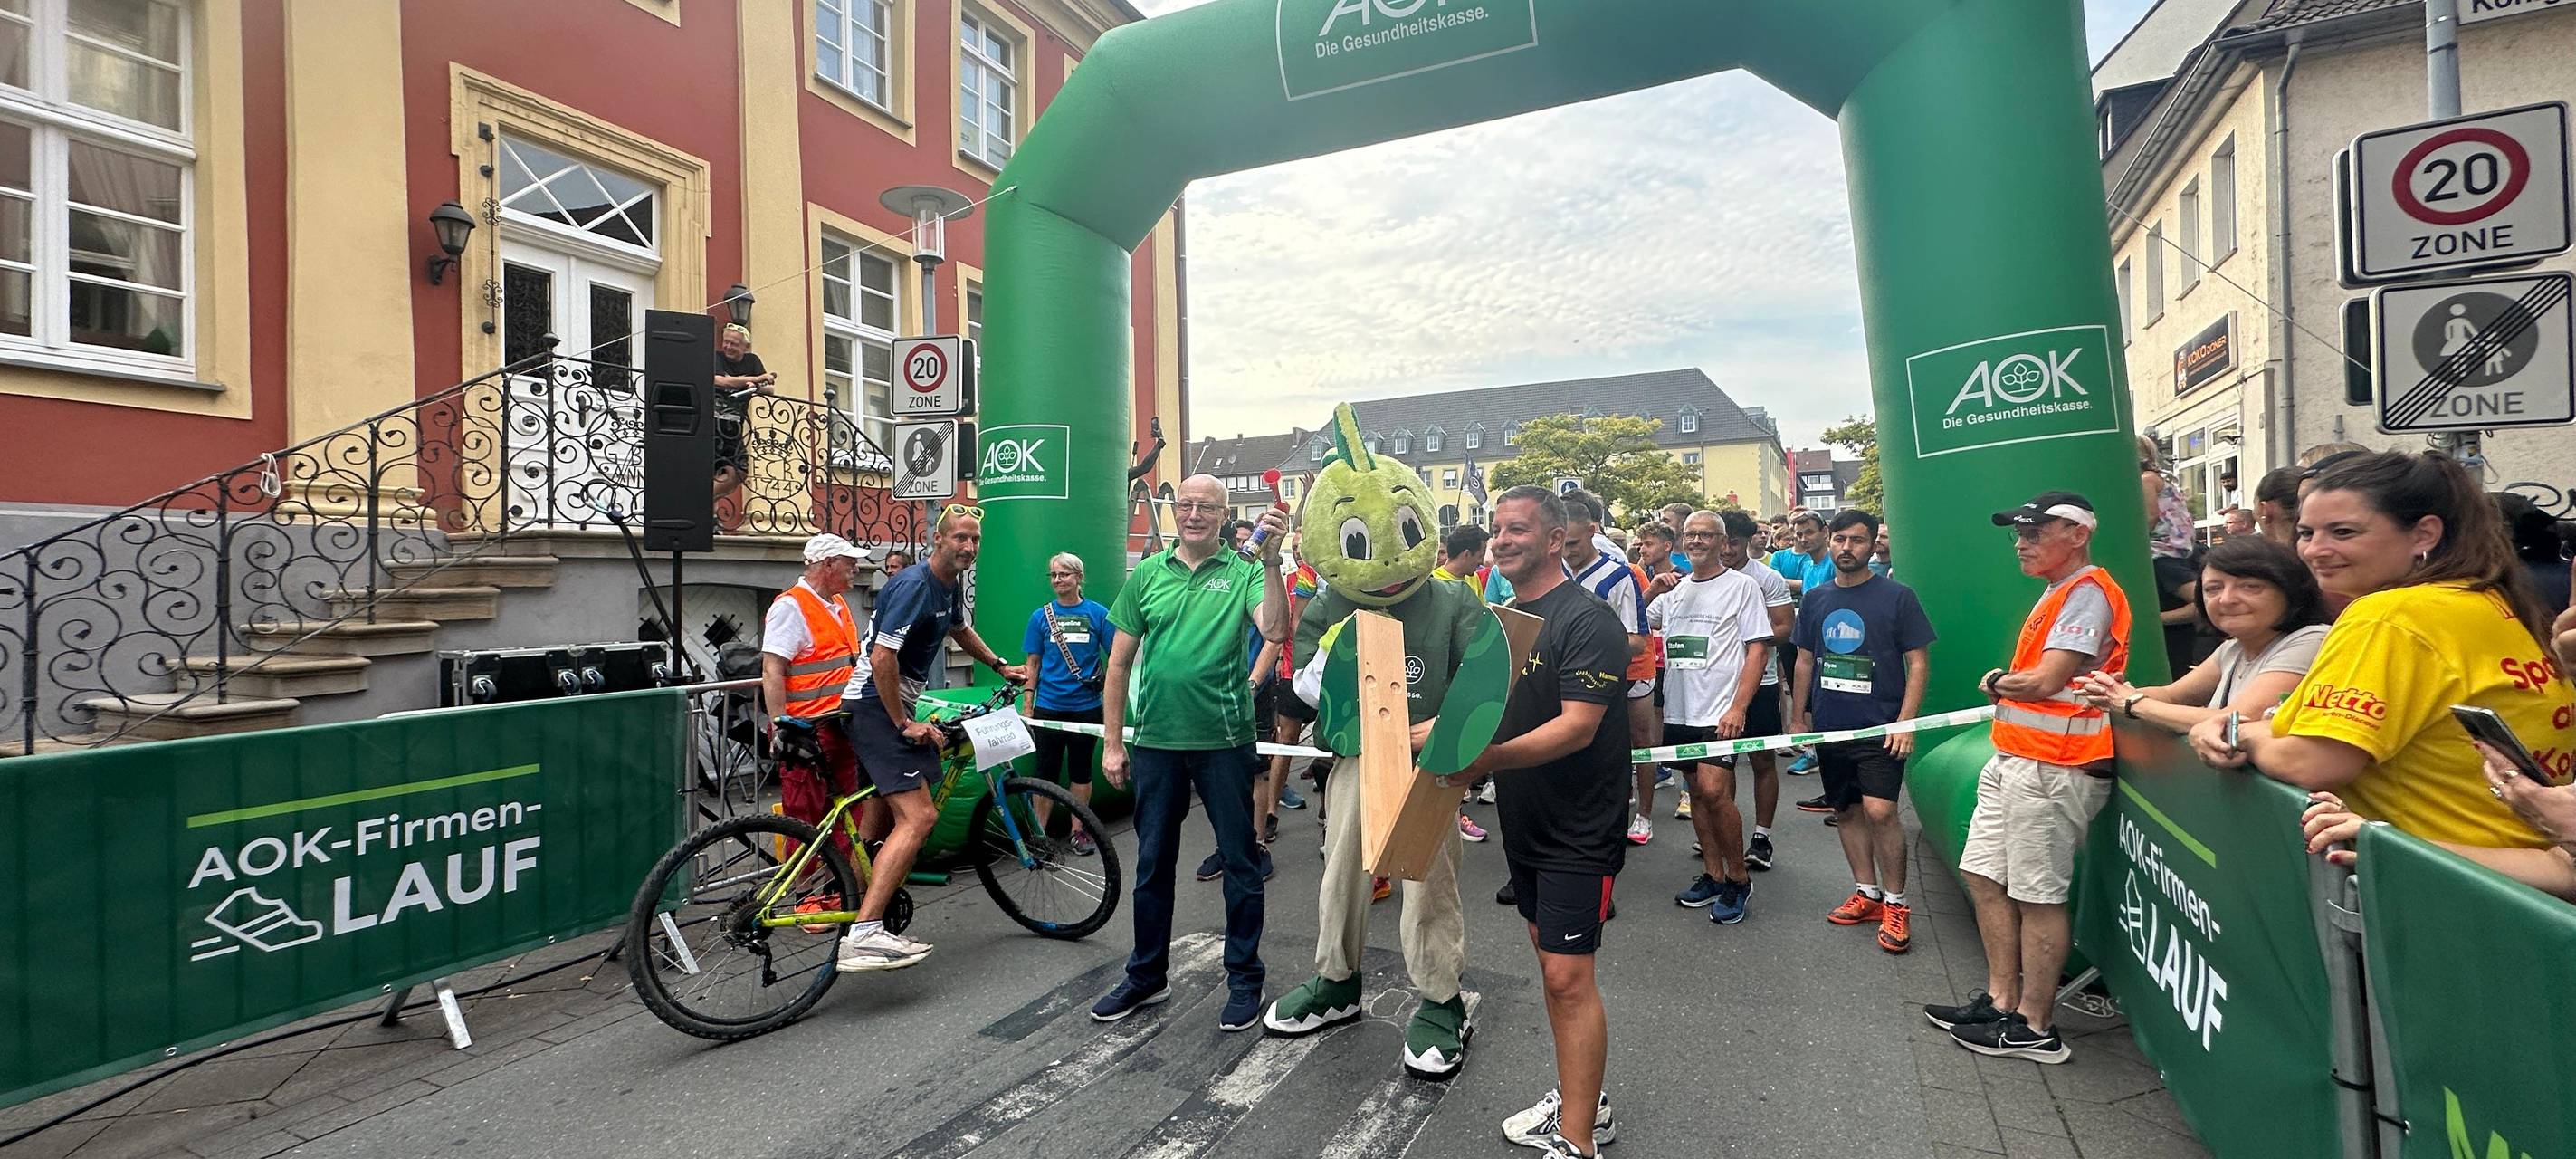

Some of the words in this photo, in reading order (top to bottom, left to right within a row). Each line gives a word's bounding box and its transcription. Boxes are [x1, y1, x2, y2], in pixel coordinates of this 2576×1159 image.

[1315, 41, 1339, 59] Die
[1342, 6, 1490, 53] Gesundheitskasse.
[2422, 151, 2500, 204] 20
[2411, 224, 2514, 261] ZONE
[913, 356, 938, 379] 20
[1945, 347, 2089, 415] AOK
[909, 395, 941, 408] ZONE
[1942, 415, 1963, 429] Die
[1967, 399, 2094, 425] Gesundheitskasse.
[2429, 391, 2524, 418] ZONE
[980, 439, 1045, 477] AOK
[908, 480, 939, 493] ZONE
[1201, 578, 1232, 590] AOK
[2304, 684, 2387, 721] Netto
[187, 801, 541, 889] AOK-Firmen-
[333, 835, 541, 936] LAUF
[2119, 813, 2220, 943] AOK-Firmen-
[2147, 902, 2228, 1053] LAUF
